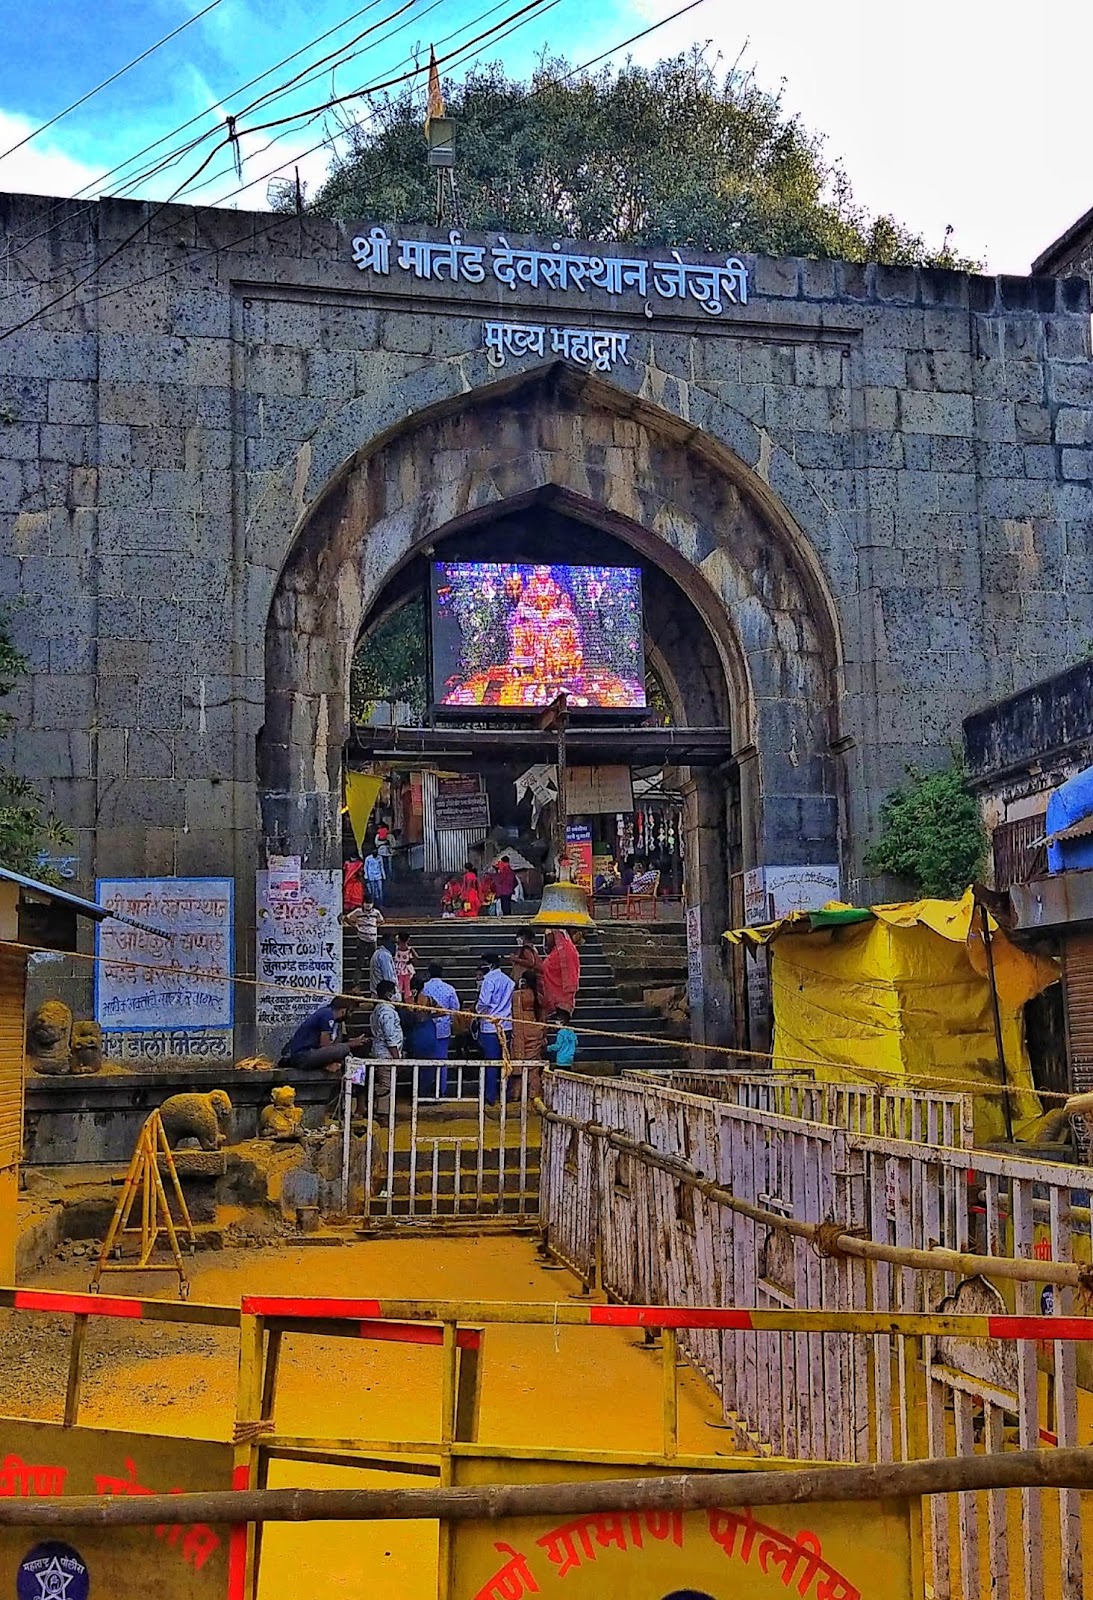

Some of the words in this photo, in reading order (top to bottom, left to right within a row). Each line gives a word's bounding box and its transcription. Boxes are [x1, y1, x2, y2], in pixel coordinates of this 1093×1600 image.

[351, 227, 391, 275] श्री
[397, 230, 486, 284] मार्तंड
[491, 237, 648, 298] देवसंस्थान
[653, 250, 750, 316] जेजुरी
[484, 322, 546, 368] मुख्य
[550, 327, 632, 372] महाद्वार
[260, 937, 295, 958] मंदिरात
